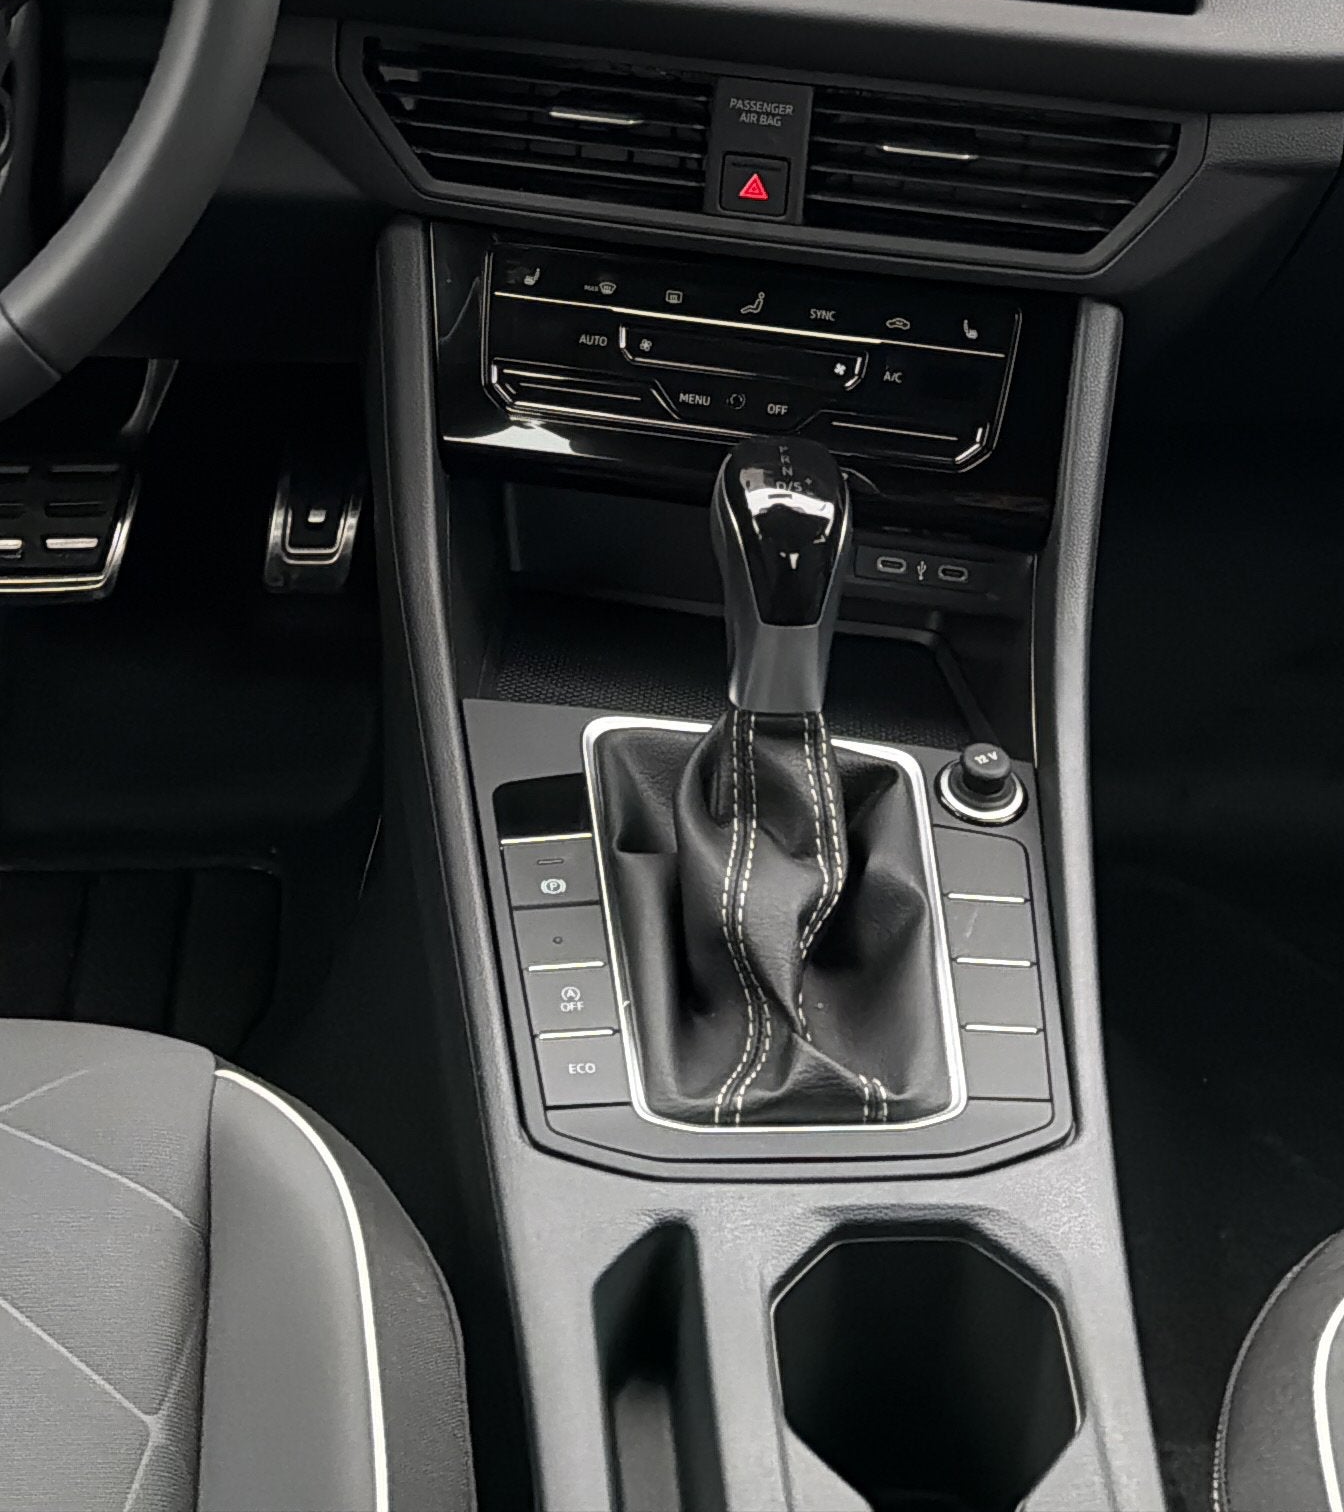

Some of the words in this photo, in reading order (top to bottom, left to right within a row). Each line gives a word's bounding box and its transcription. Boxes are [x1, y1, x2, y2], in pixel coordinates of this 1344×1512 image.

[729, 97, 794, 116] PASSENGER
[739, 112, 758, 124] AIR
[759, 114, 782, 127] BAG
[809, 308, 836, 322] SYNC
[578, 334, 608, 347] AUTO
[883, 371, 903, 383] A/C
[679, 393, 711, 407] MENU
[767, 403, 788, 416] OFF
[782, 466, 793, 476] N
[560, 1001, 584, 1012] OFF
[568, 1063, 596, 1074] ECO
